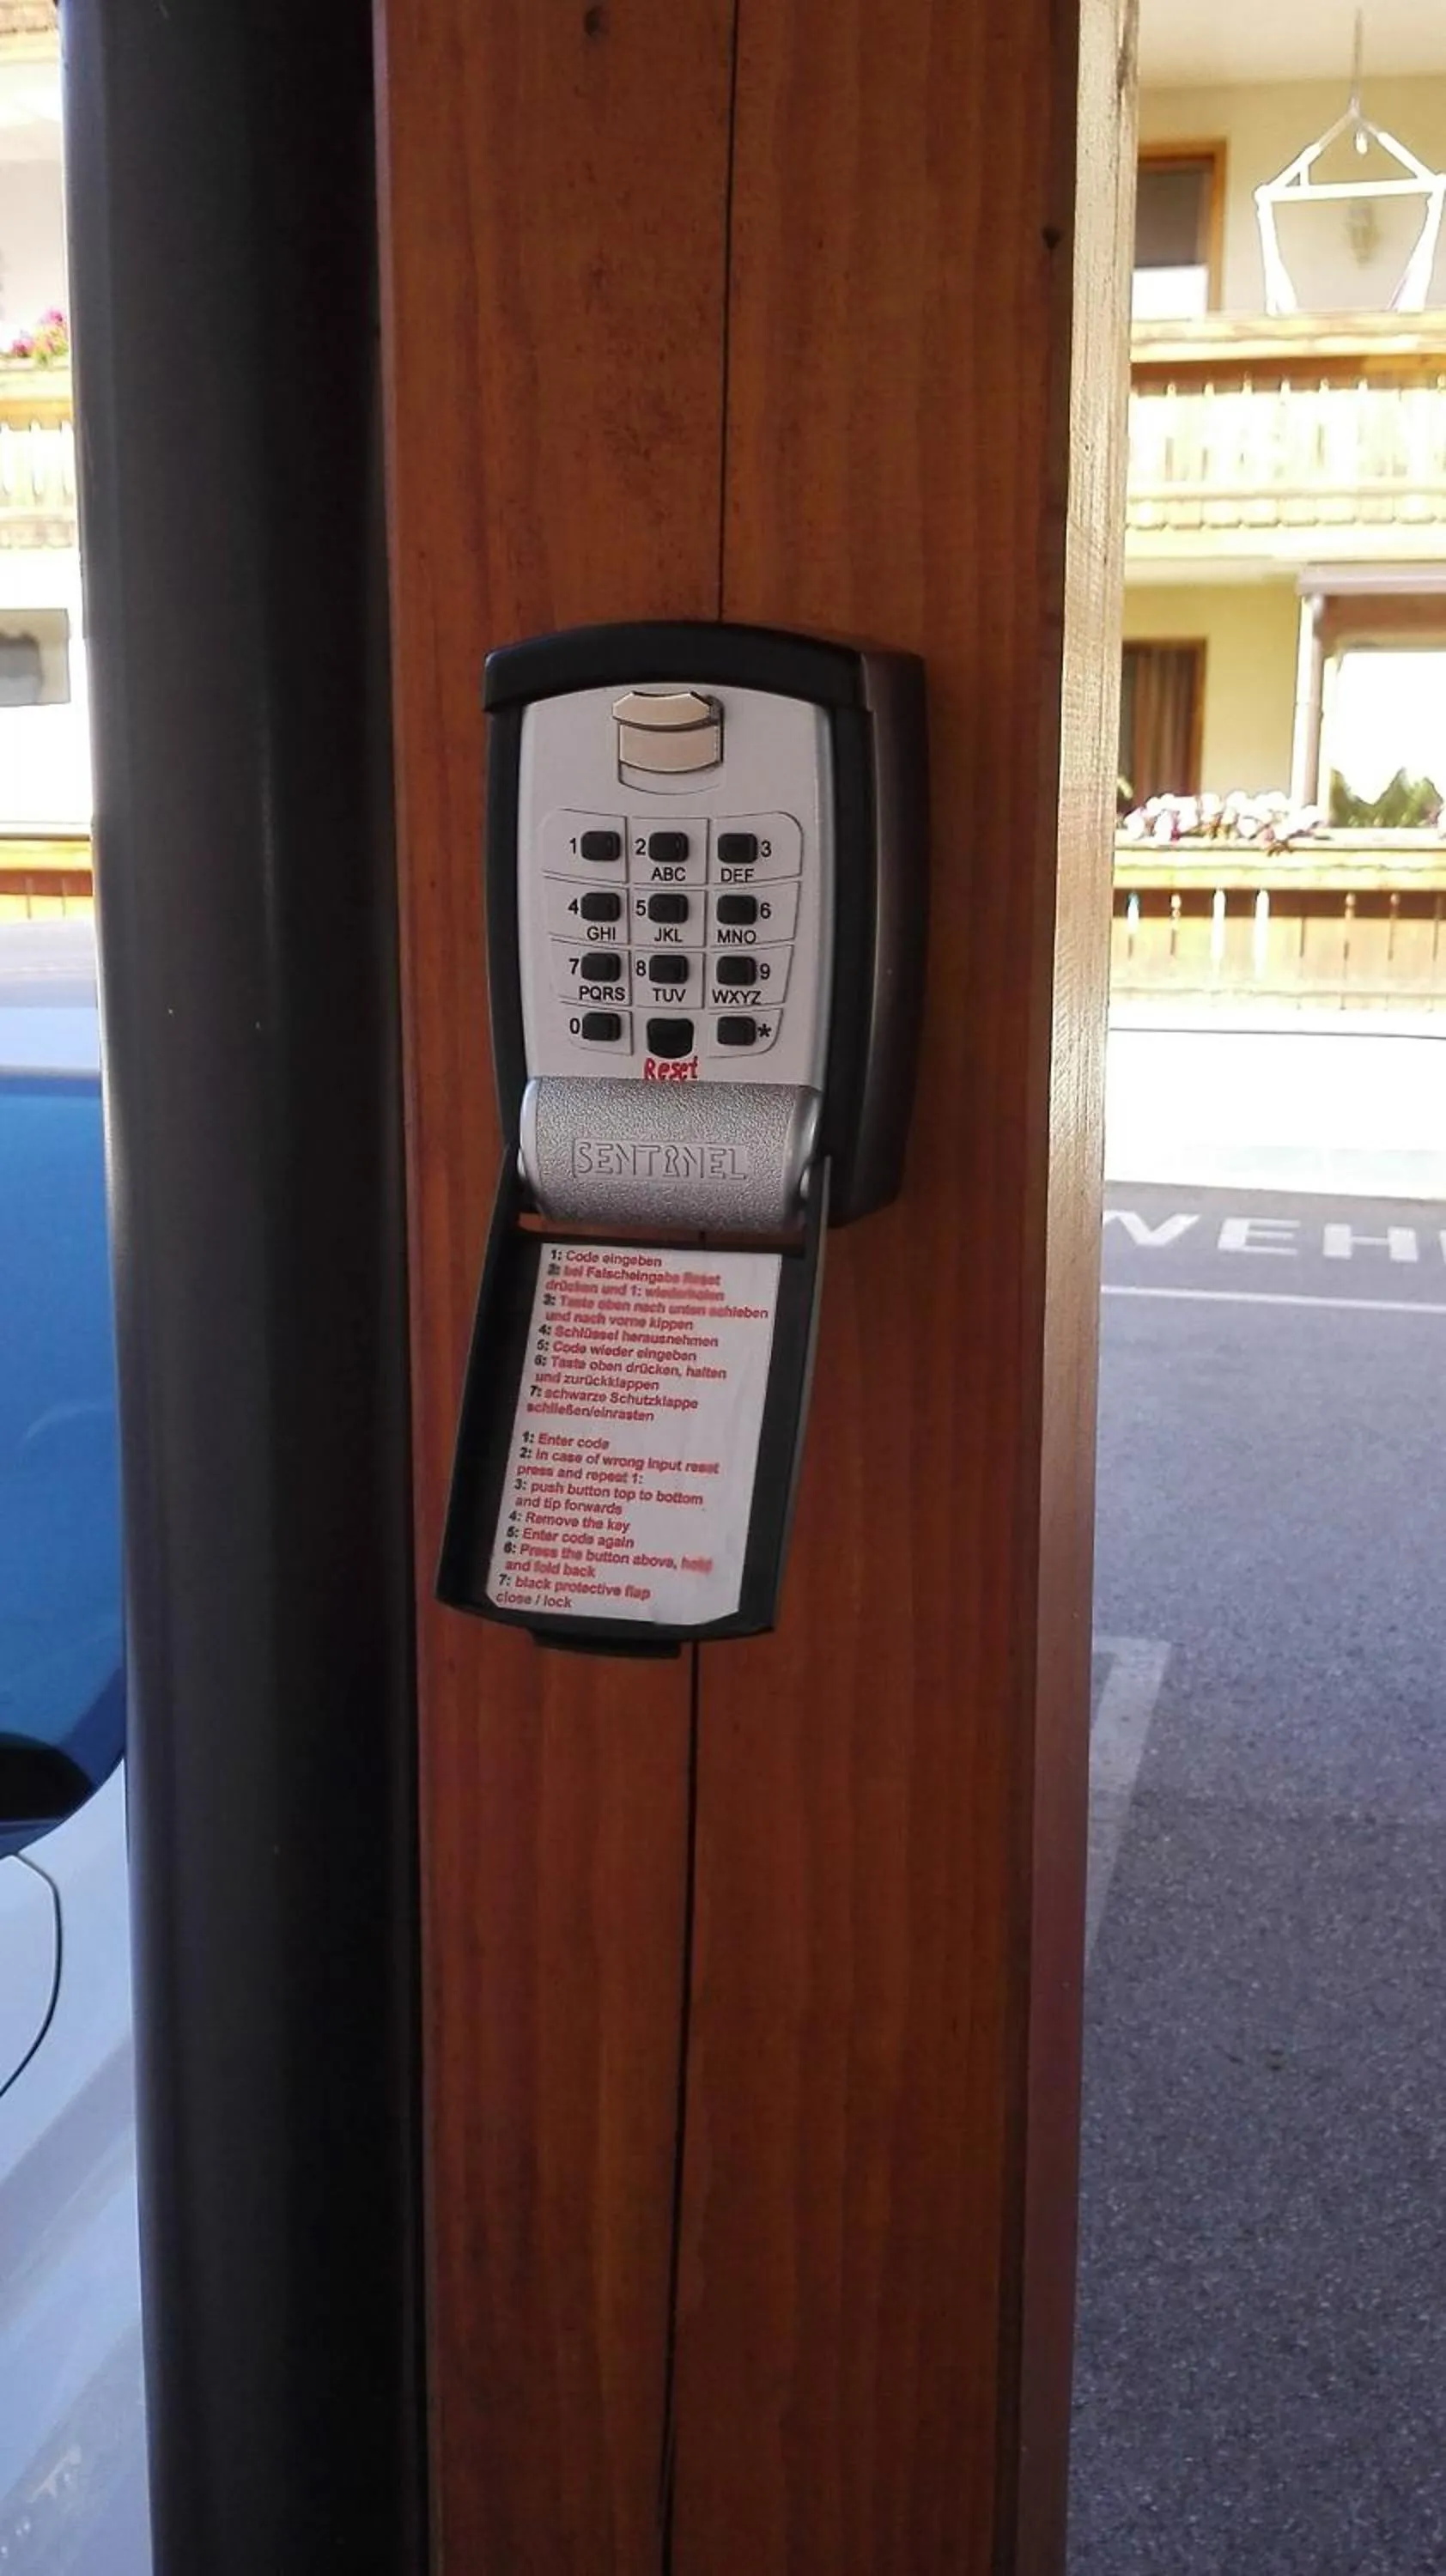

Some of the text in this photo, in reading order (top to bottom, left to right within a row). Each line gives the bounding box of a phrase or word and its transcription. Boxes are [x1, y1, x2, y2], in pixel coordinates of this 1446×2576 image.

[569, 839, 578, 854] 1
[635, 839, 647, 855] 2
[760, 841, 772, 857] 3
[651, 866, 686, 882] ABC
[720, 868, 755, 883] DEF
[568, 898, 579, 914] 4
[635, 900, 647, 916] 5
[760, 902, 771, 919] 6
[586, 927, 617, 941] GHI
[653, 927, 684, 943] JKL
[717, 929, 757, 945] MNO
[568, 958, 580, 975] 7
[635, 961, 647, 977] 8
[759, 963, 770, 980] 9
[579, 986, 626, 1002] PQRS
[653, 988, 686, 1003] TUV
[712, 989, 762, 1005] WXYZ
[569, 1018, 580, 1035] 0
[643, 1055, 699, 1082] Reset
[551, 1250, 662, 1267] 1: Code eingeben
[708, 1305, 769, 1319] schieben
[546, 1311, 571, 1322] und
[649, 1317, 693, 1332] kippen
[538, 1323, 719, 1347] 4: Schlüssel herausnehmen
[537, 1339, 696, 1363] 5: Code wieder eingeben
[534, 1354, 727, 1379] 6: Taste oben drücken, halten
[535, 1371, 659, 1391] und zurückklappen
[530, 1384, 698, 1411] 7: schwarze Schutzklappe
[522, 1430, 610, 1449] 1: Enter code
[519, 1446, 532, 1459] 2:
[551, 1451, 583, 1463] case
[586, 1453, 600, 1465] of
[603, 1455, 645, 1471] wrong
[647, 1456, 683, 1473] input
[684, 1461, 720, 1474] reset
[516, 1465, 644, 1484] press and repeat 1:
[513, 1478, 703, 1505] 3: push button top to bottom
[515, 1496, 623, 1516] and tip forwards
[507, 1510, 631, 1534] 4: Remove the key
[506, 1526, 635, 1550] 5: Enter code again
[503, 1541, 516, 1554] 6:
[519, 1543, 558, 1558] Press
[561, 1546, 583, 1560] the
[586, 1548, 630, 1564] button
[632, 1553, 677, 1571] above,
[505, 1560, 532, 1572] and
[562, 1564, 595, 1578] back
[498, 1573, 651, 1601] 7: black protective flap
[495, 1591, 532, 1605] close
[544, 1595, 573, 1608] lock
